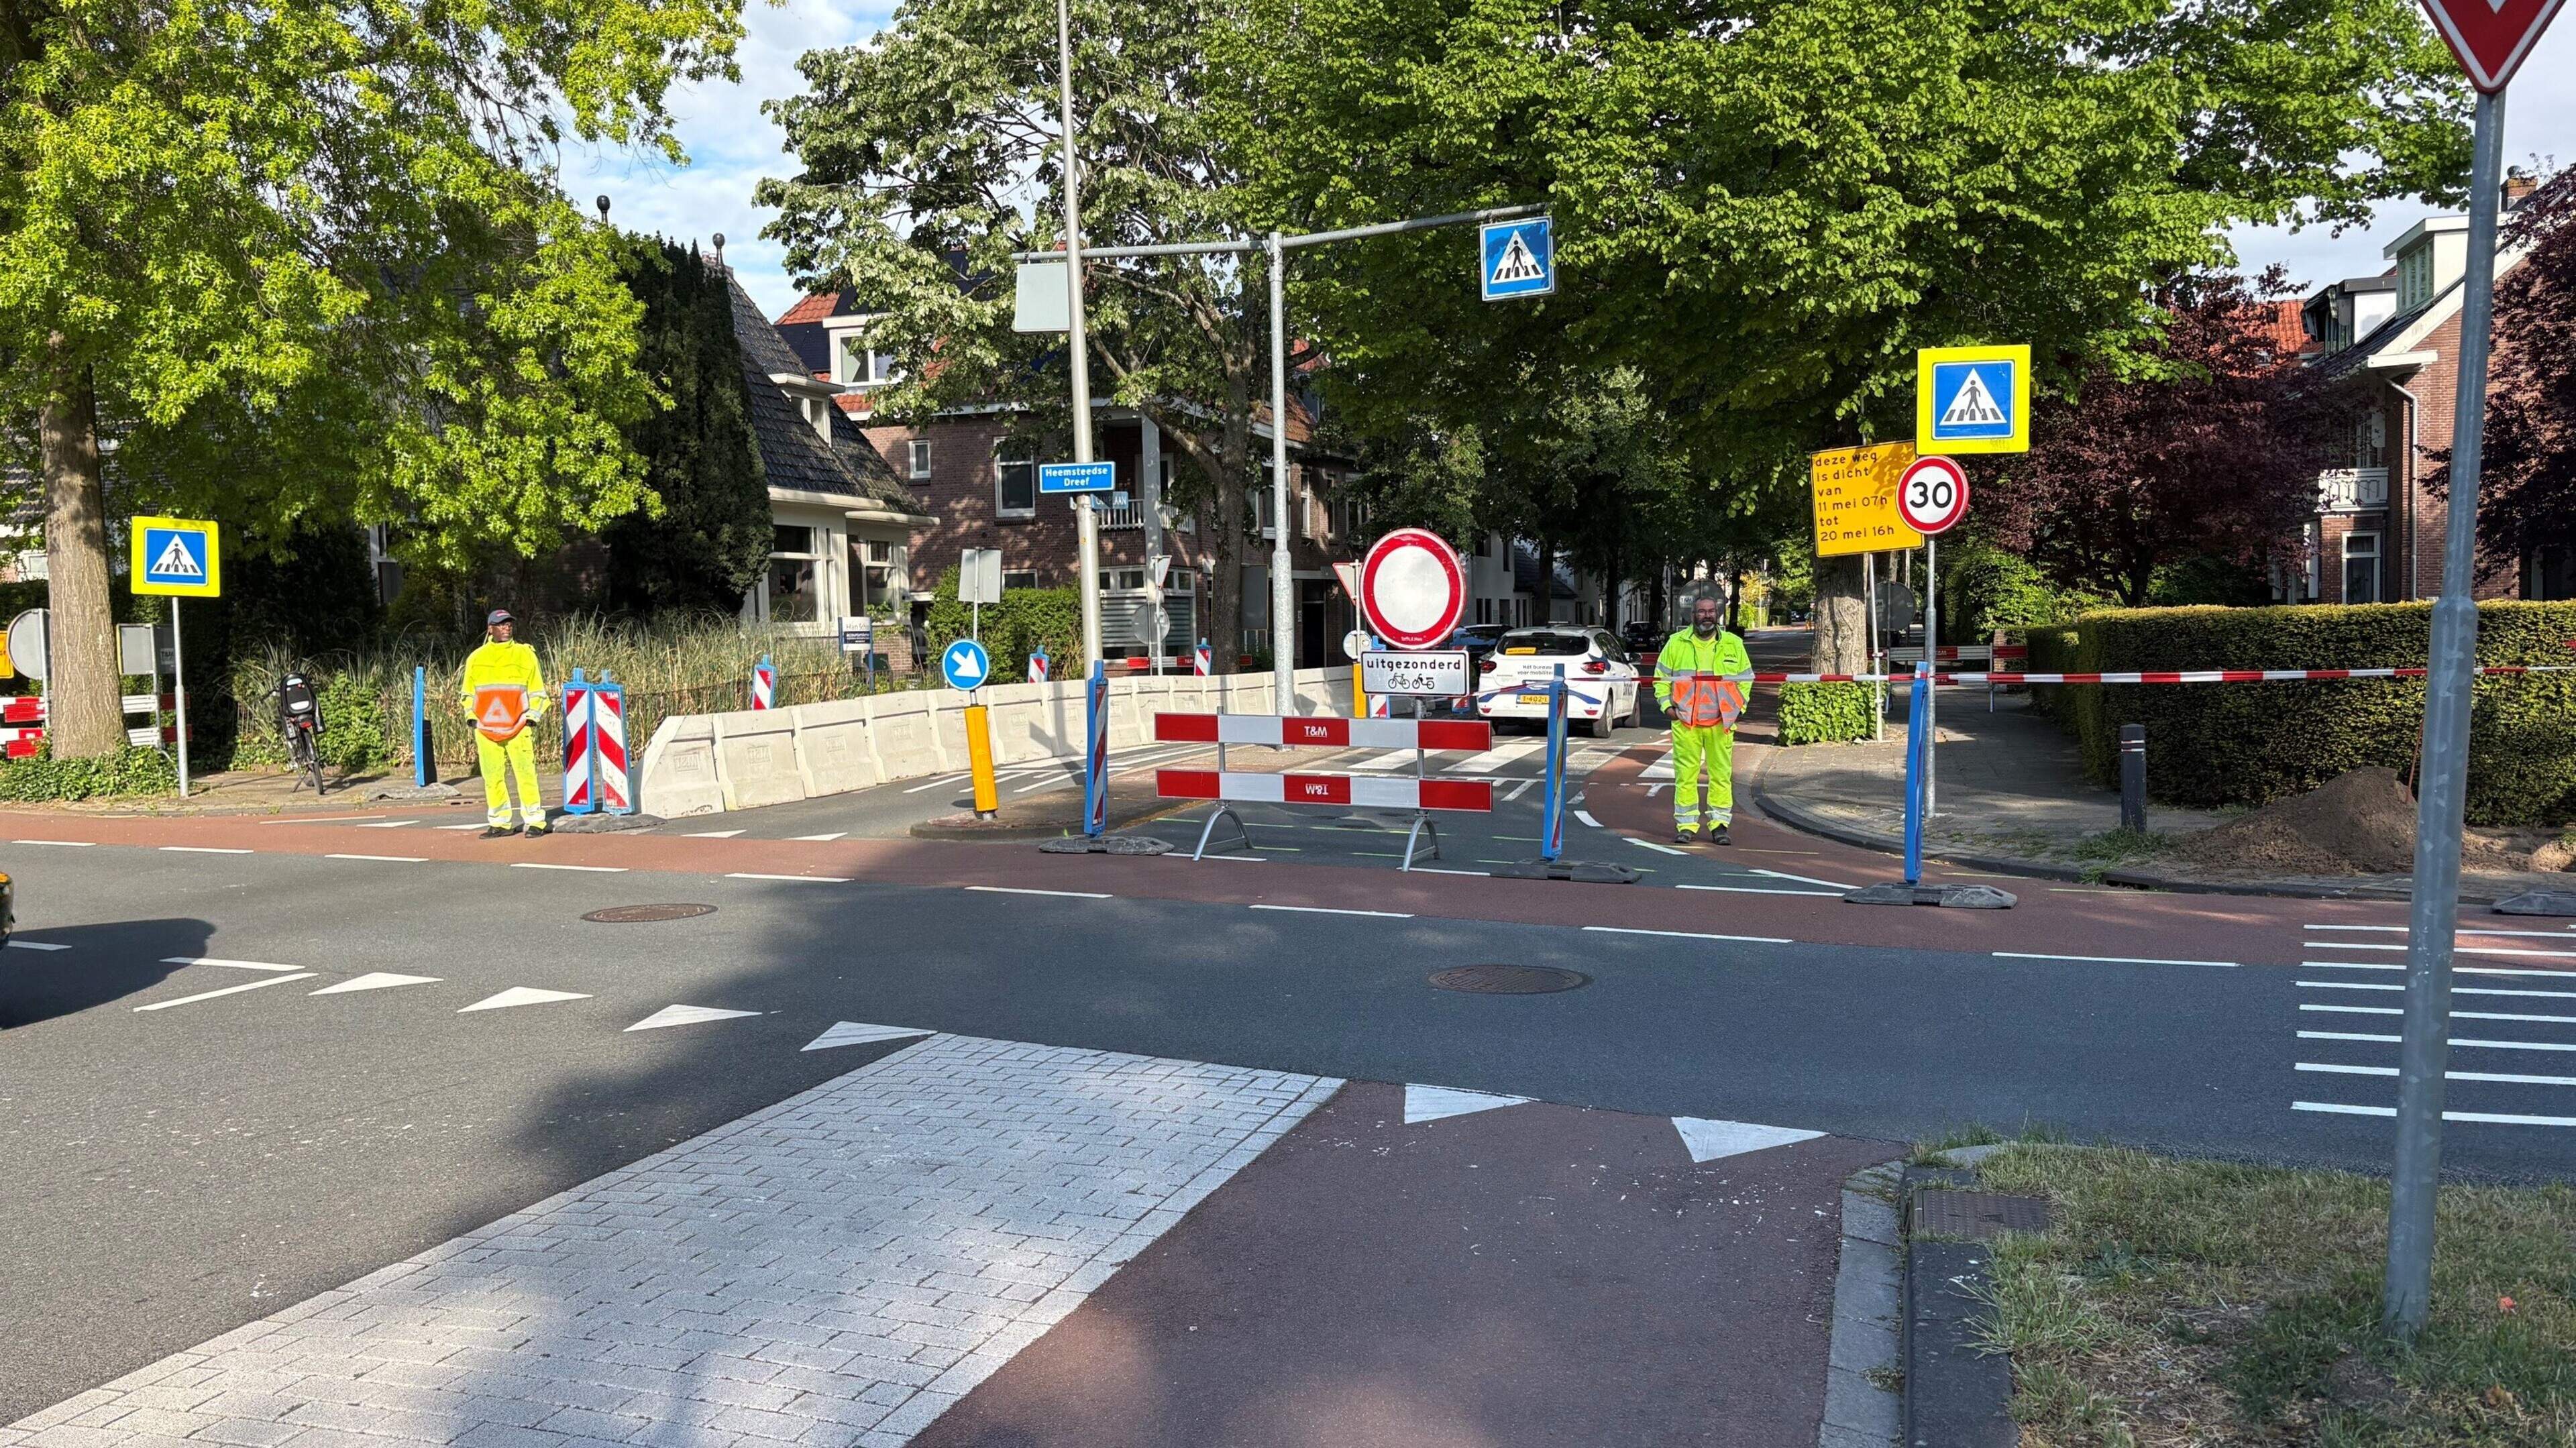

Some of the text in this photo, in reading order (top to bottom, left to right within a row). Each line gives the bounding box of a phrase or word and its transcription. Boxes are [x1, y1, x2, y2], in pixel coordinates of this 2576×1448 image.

[1815, 452, 1877, 466] deze weg
[1045, 466, 1108, 477] Heemsteedse
[1817, 467, 1869, 482] is dicht
[1064, 477, 1089, 486] Dreef
[1818, 487, 1841, 497] van
[1909, 482, 1952, 508] 30
[1818, 496, 1888, 512] 11 mei 07h
[1819, 516, 1839, 526] tot
[1821, 525, 1894, 541] 20 mei 16h
[1366, 658, 1460, 671] uitgezonderd
[1304, 726, 1328, 736] T&M
[1305, 784, 1328, 795] T&M
